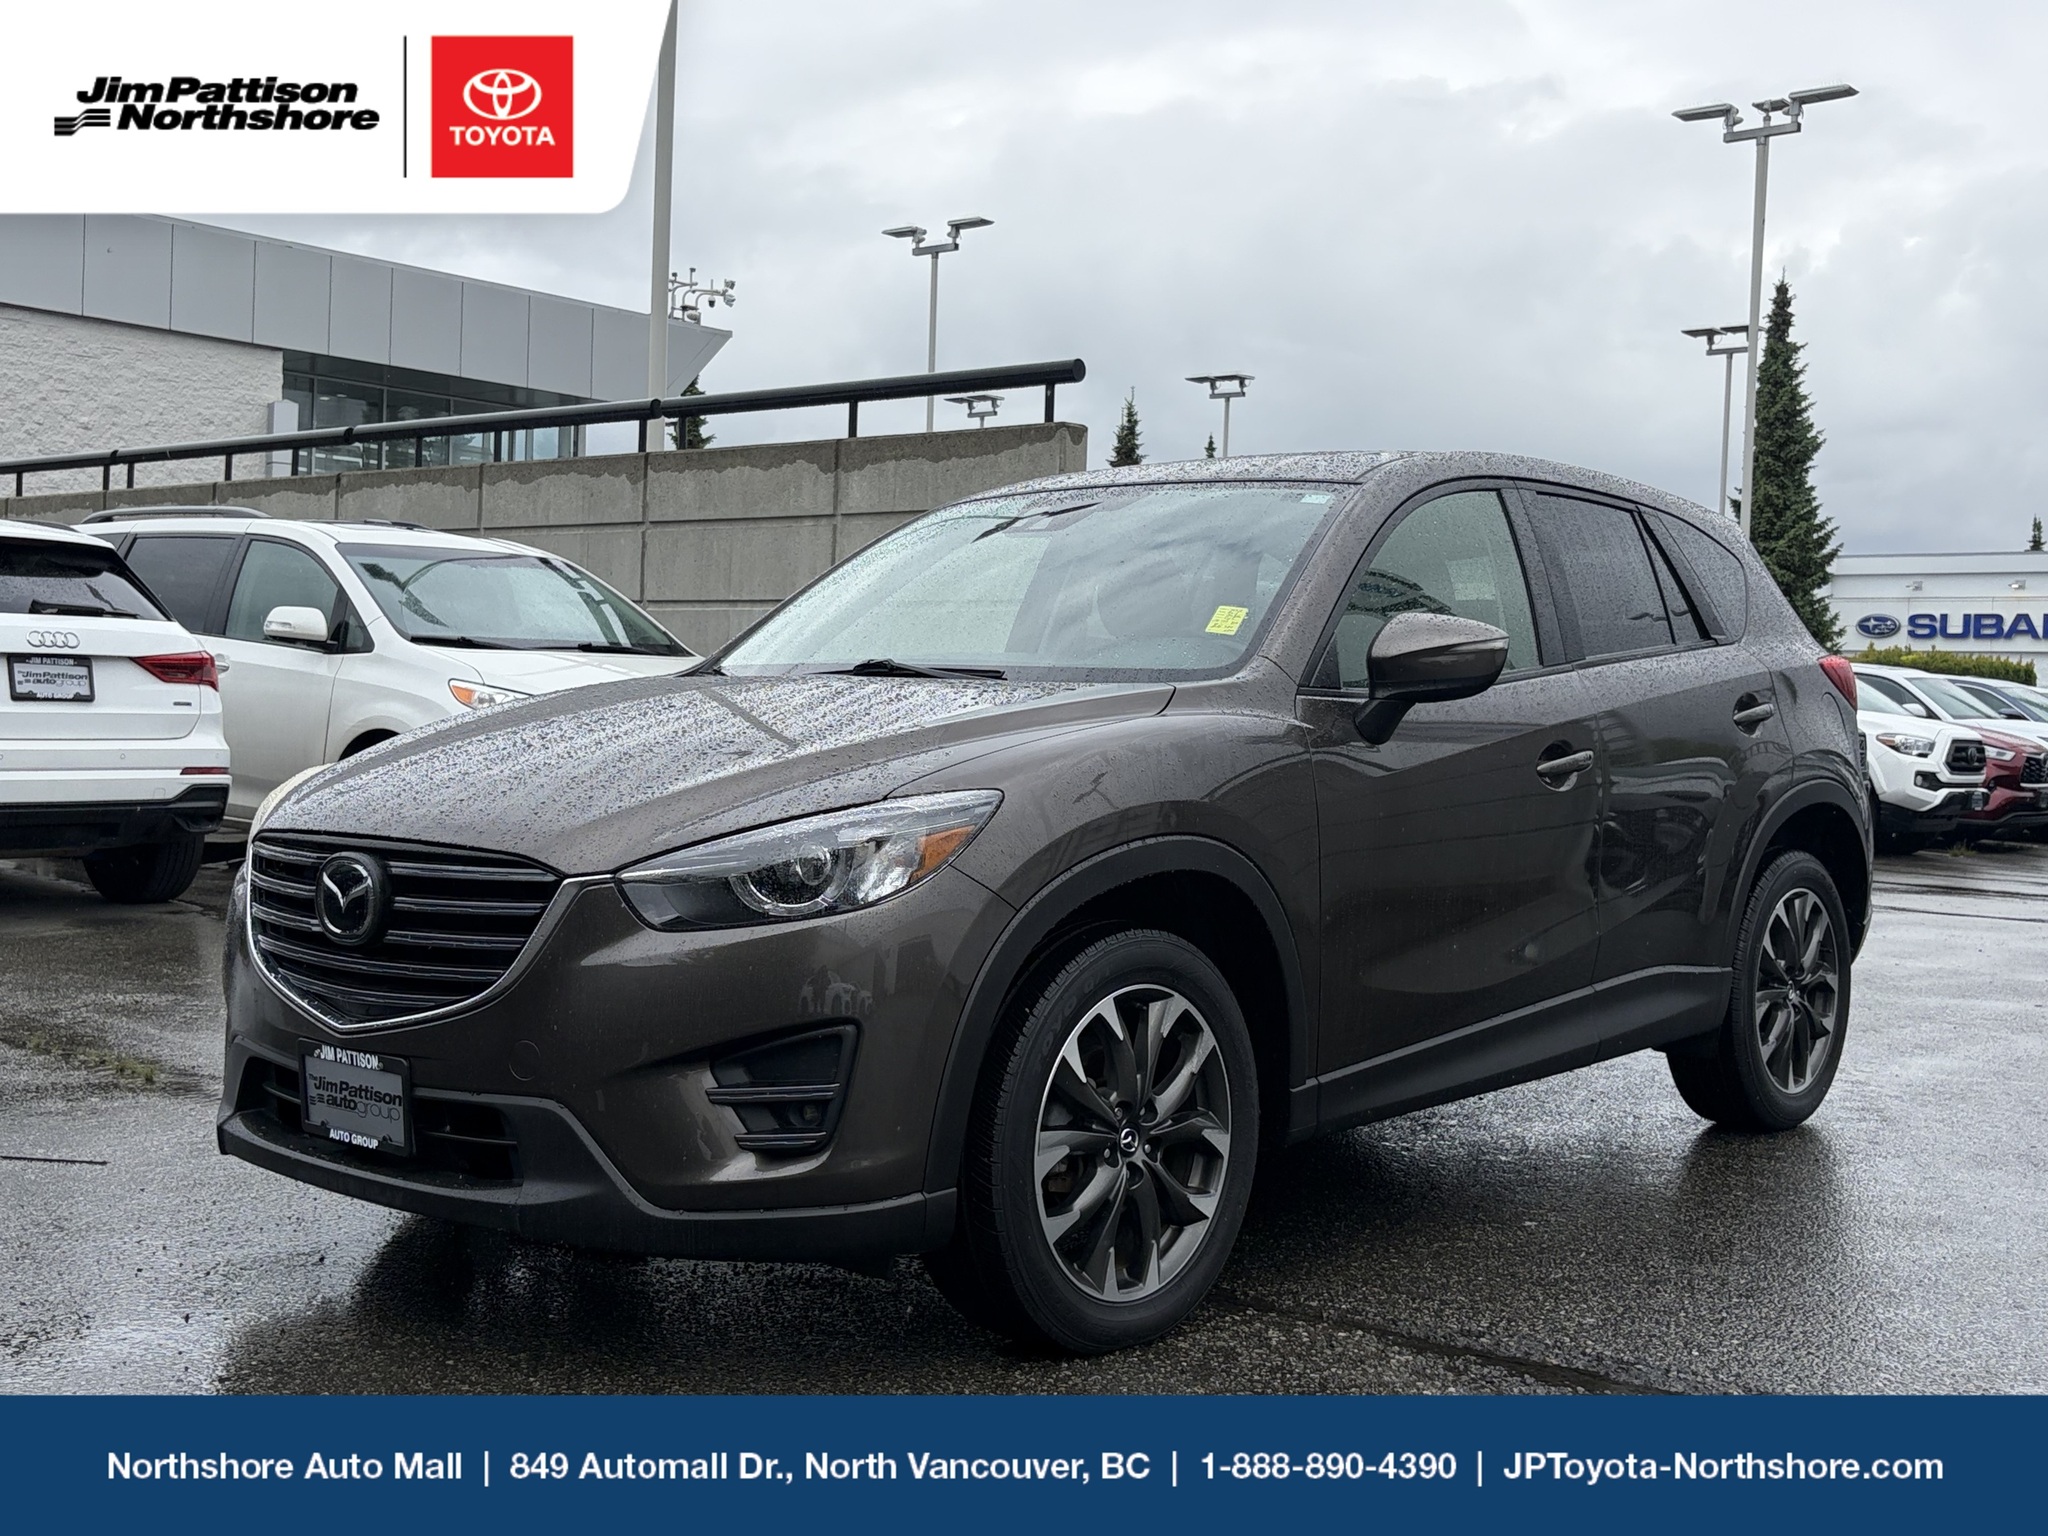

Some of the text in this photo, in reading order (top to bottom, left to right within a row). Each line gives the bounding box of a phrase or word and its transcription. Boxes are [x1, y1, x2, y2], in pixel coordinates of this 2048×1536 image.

[1907, 613, 2048, 640] SUBA
[42, 657, 74, 666] PATTISON
[43, 671, 88, 680] Pattison
[320, 1044, 379, 1070] JIM PATTISON
[314, 1076, 402, 1107] Jim Pattison
[329, 1128, 379, 1149] AUTO GROUP
